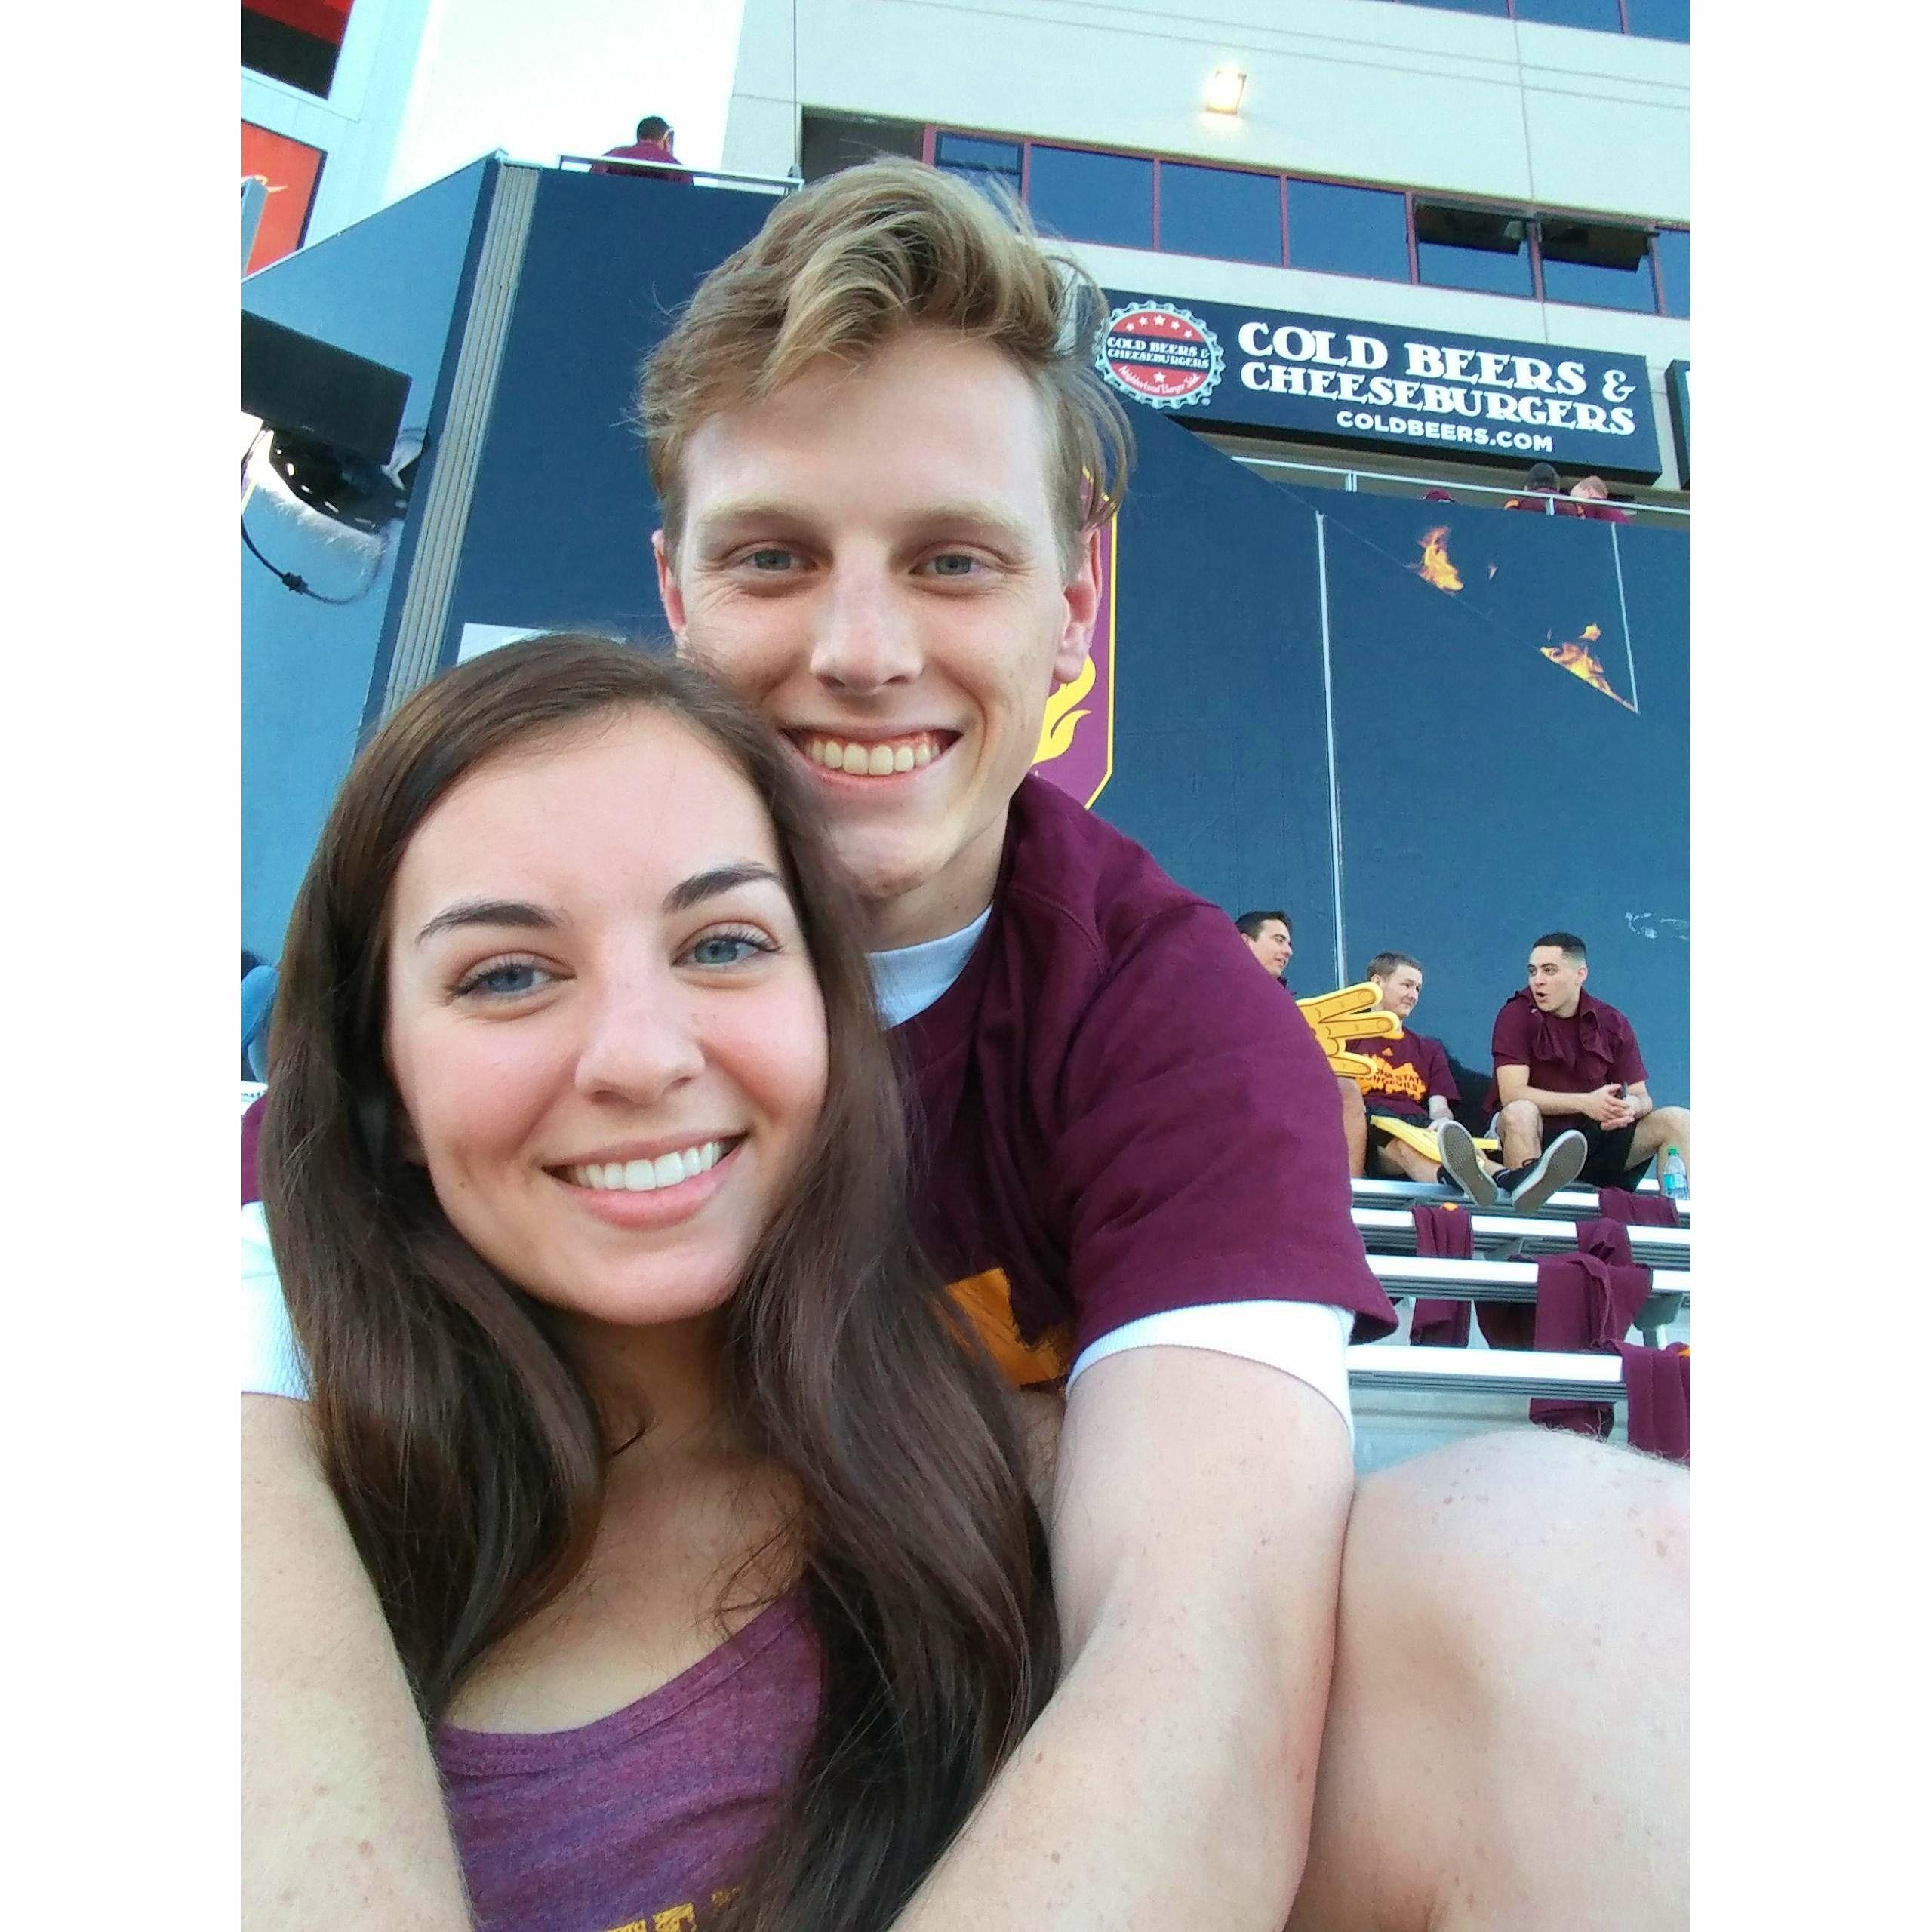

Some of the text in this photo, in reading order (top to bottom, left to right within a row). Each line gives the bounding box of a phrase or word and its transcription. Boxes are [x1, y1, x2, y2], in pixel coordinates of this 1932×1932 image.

[1107, 337, 1146, 351] COLD
[1149, 342, 1198, 358] BEERS
[1107, 349, 1210, 368] CHEESEBURGERS
[1238, 321, 1389, 370] COLD
[1404, 342, 1588, 396] BEERS
[1601, 369, 1636, 403] &
[1240, 361, 1636, 436] CHEESEBURGERS
[1336, 410, 1554, 453] COLDBEERS.COM
